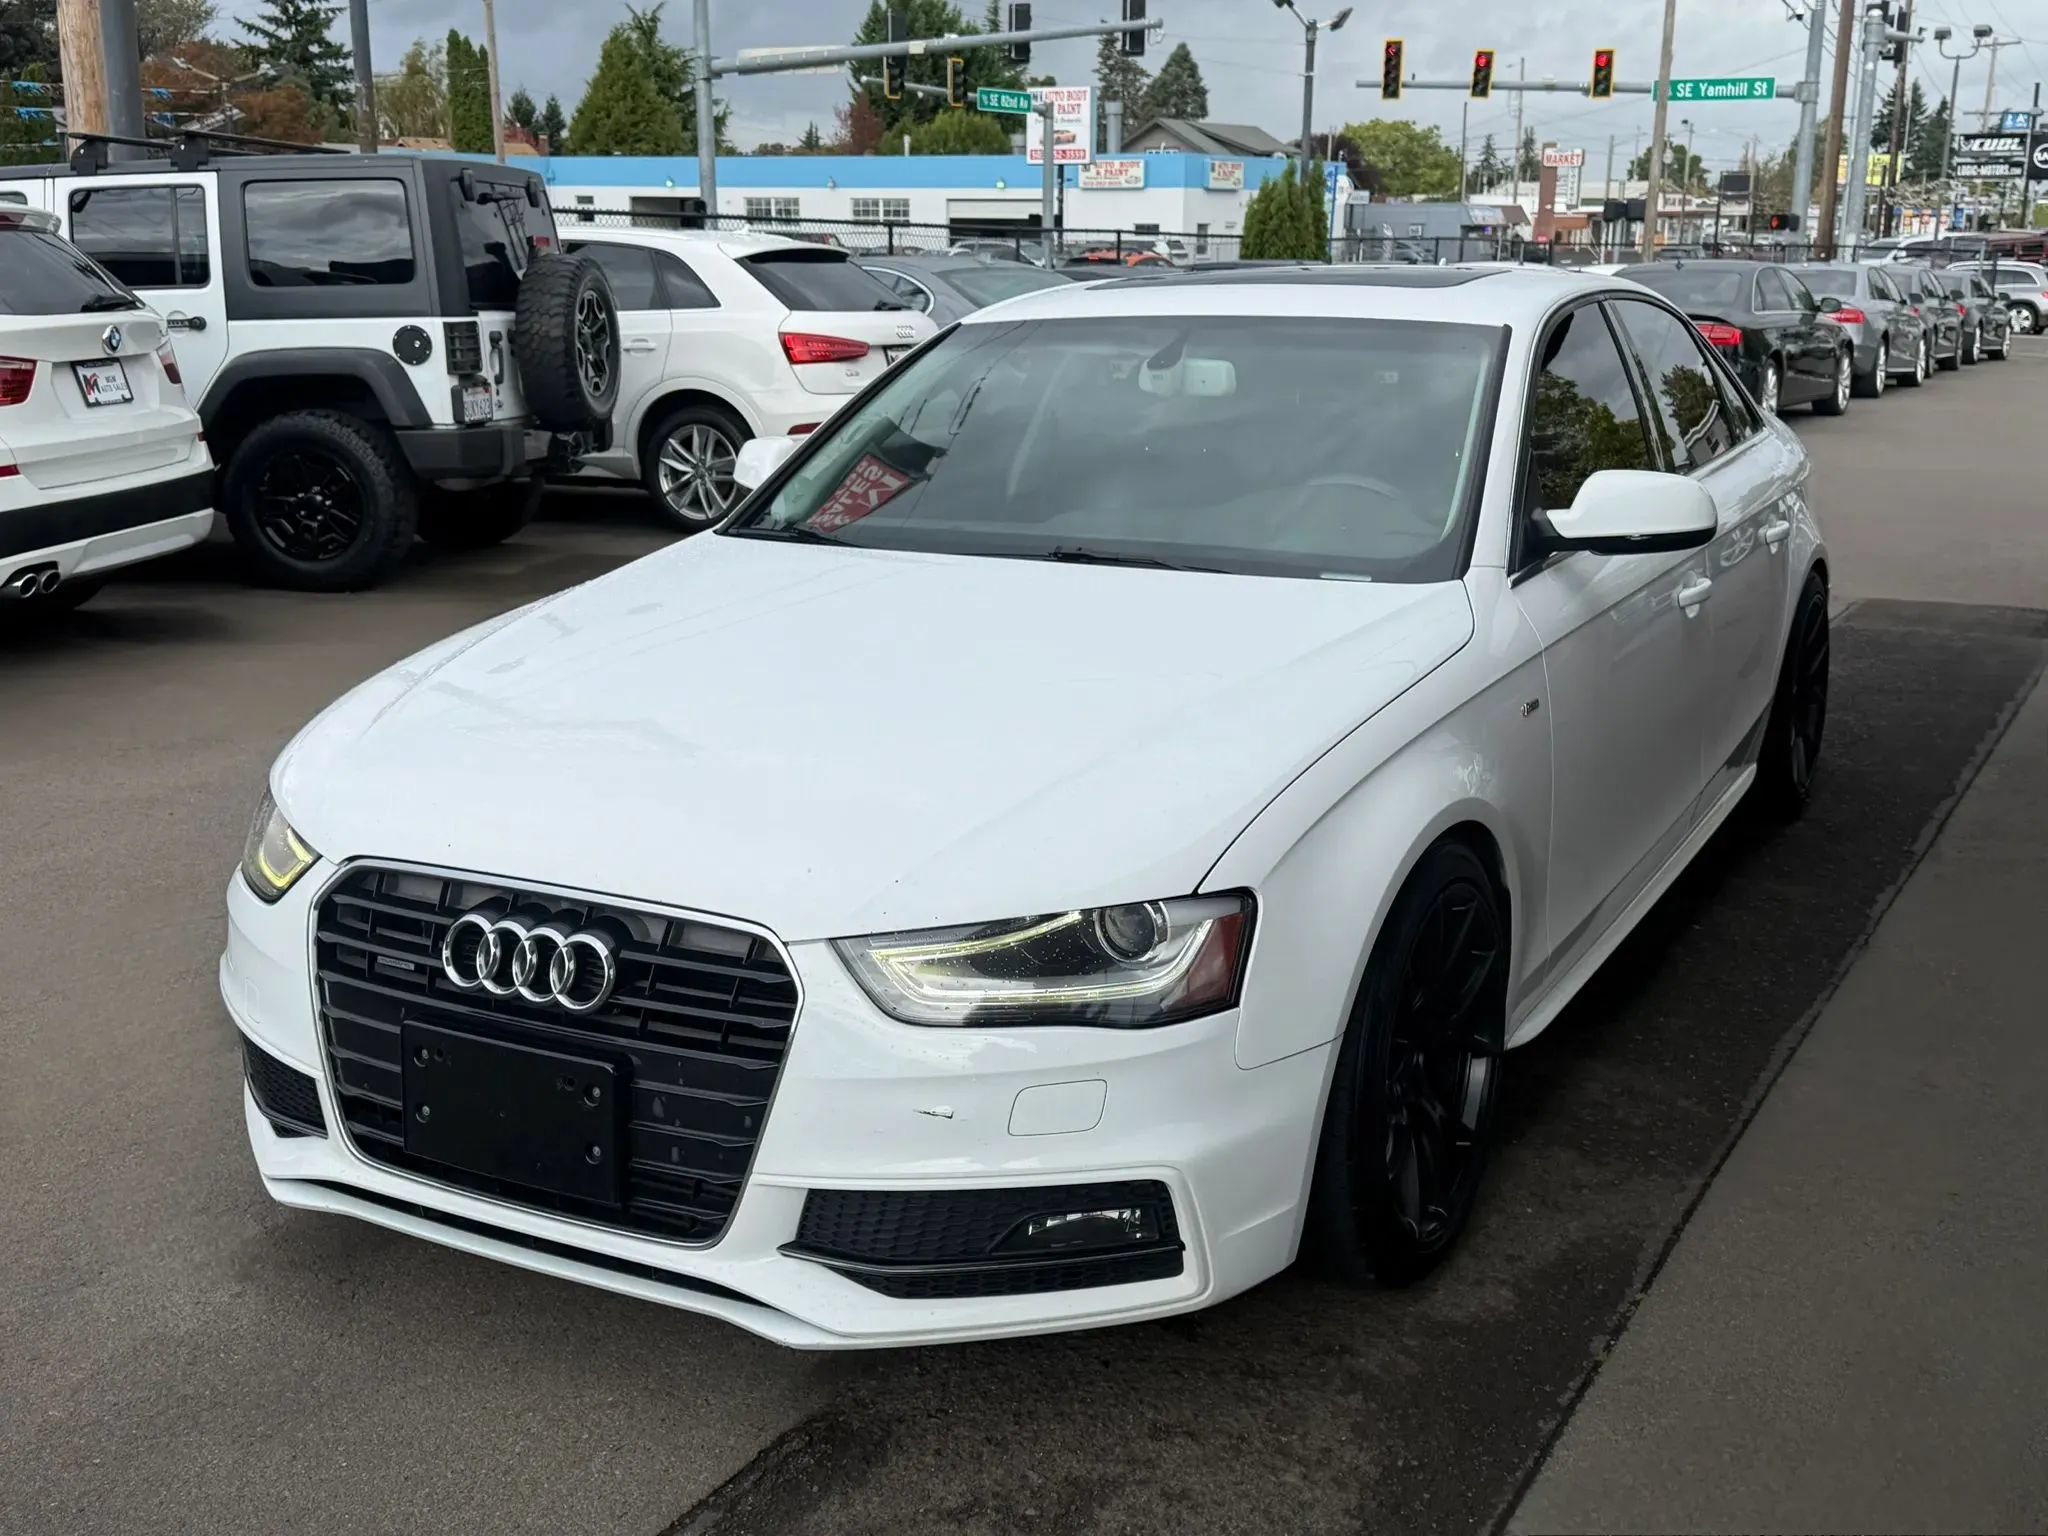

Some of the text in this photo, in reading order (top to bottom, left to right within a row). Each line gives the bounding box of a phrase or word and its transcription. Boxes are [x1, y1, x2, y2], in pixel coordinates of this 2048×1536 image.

[1045, 90, 1065, 101] AUTO
[1676, 81, 1768, 98] SE Yamhill St
[989, 92, 998, 107] SE
[1057, 103, 1082, 115] PAINT
[1545, 153, 1581, 165] MARKET
